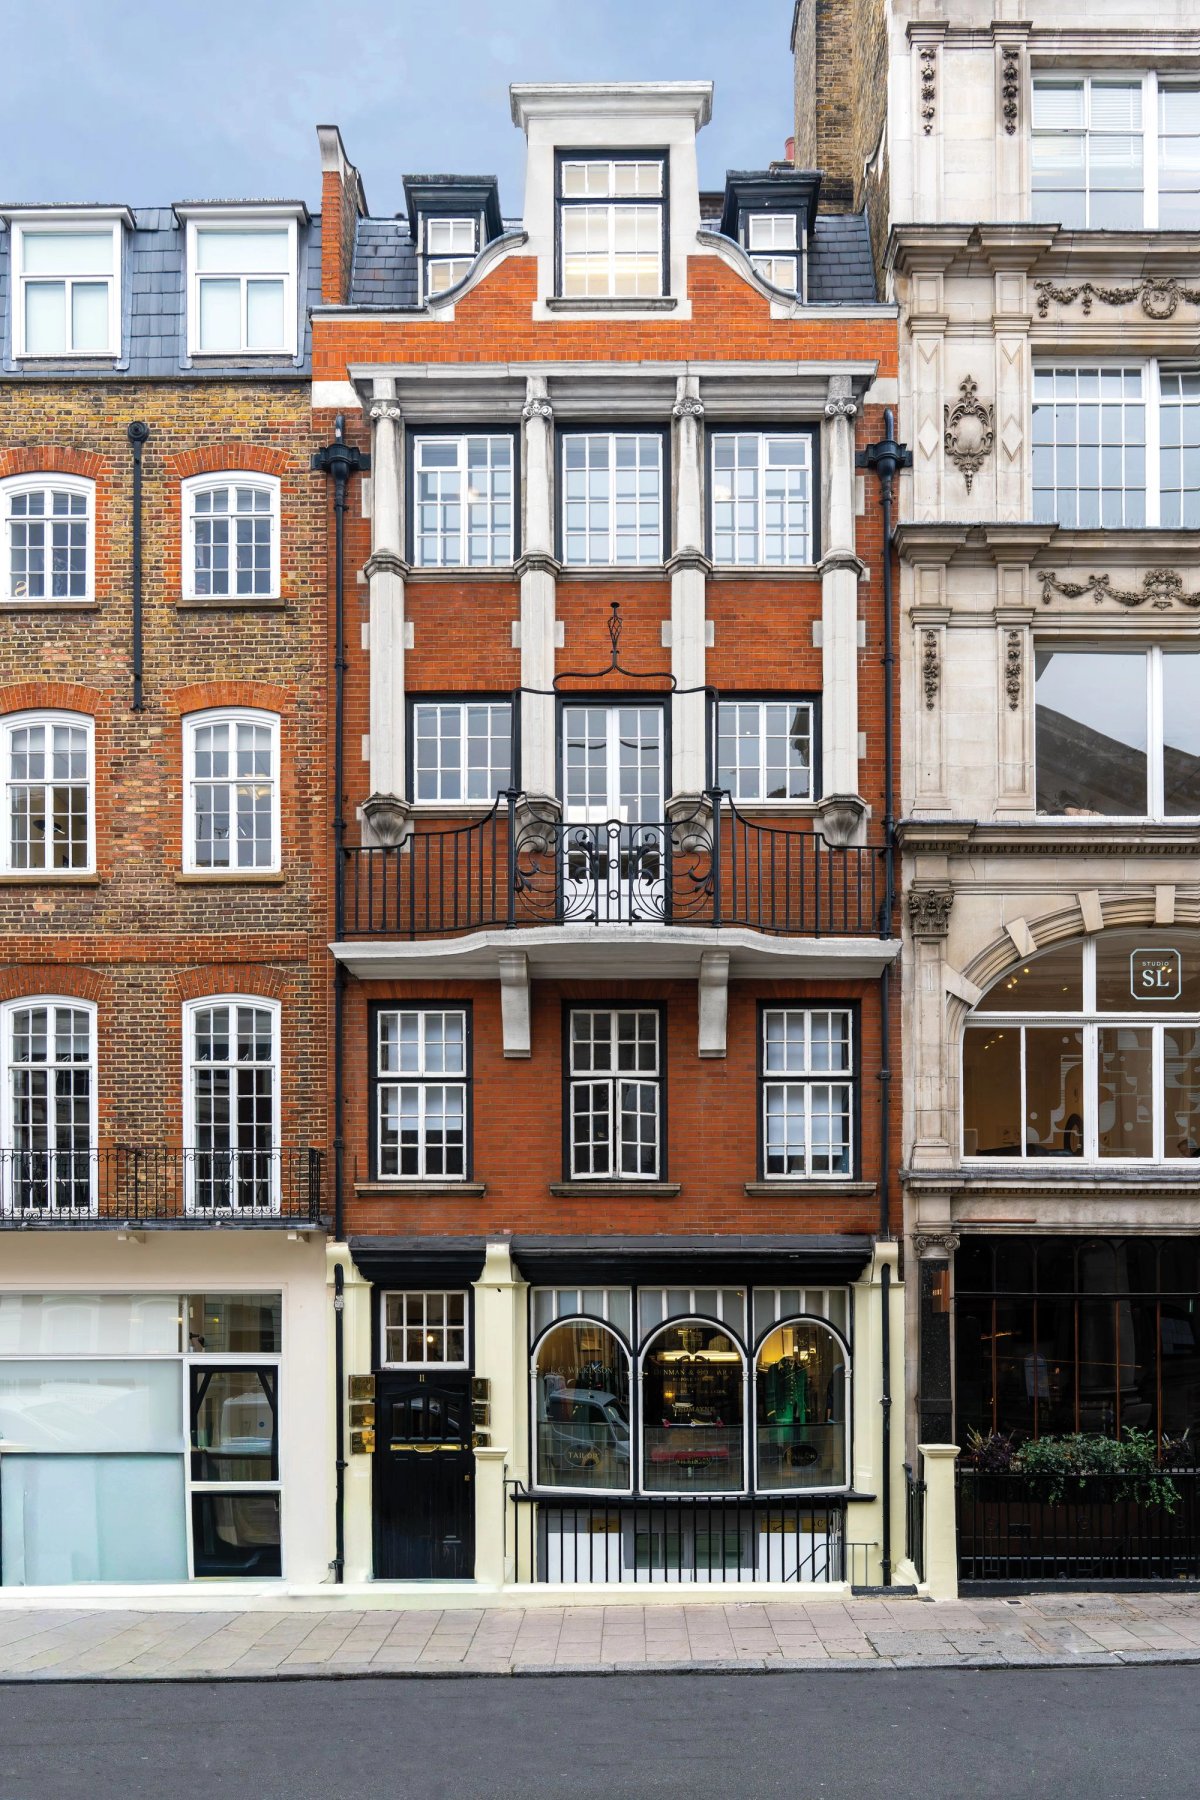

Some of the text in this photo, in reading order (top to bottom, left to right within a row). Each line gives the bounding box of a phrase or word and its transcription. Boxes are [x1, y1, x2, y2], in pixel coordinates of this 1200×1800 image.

[1142, 969, 1170, 987] SL
[568, 1366, 613, 1374] WILKINSON
[568, 1451, 599, 1459] TAILOR
